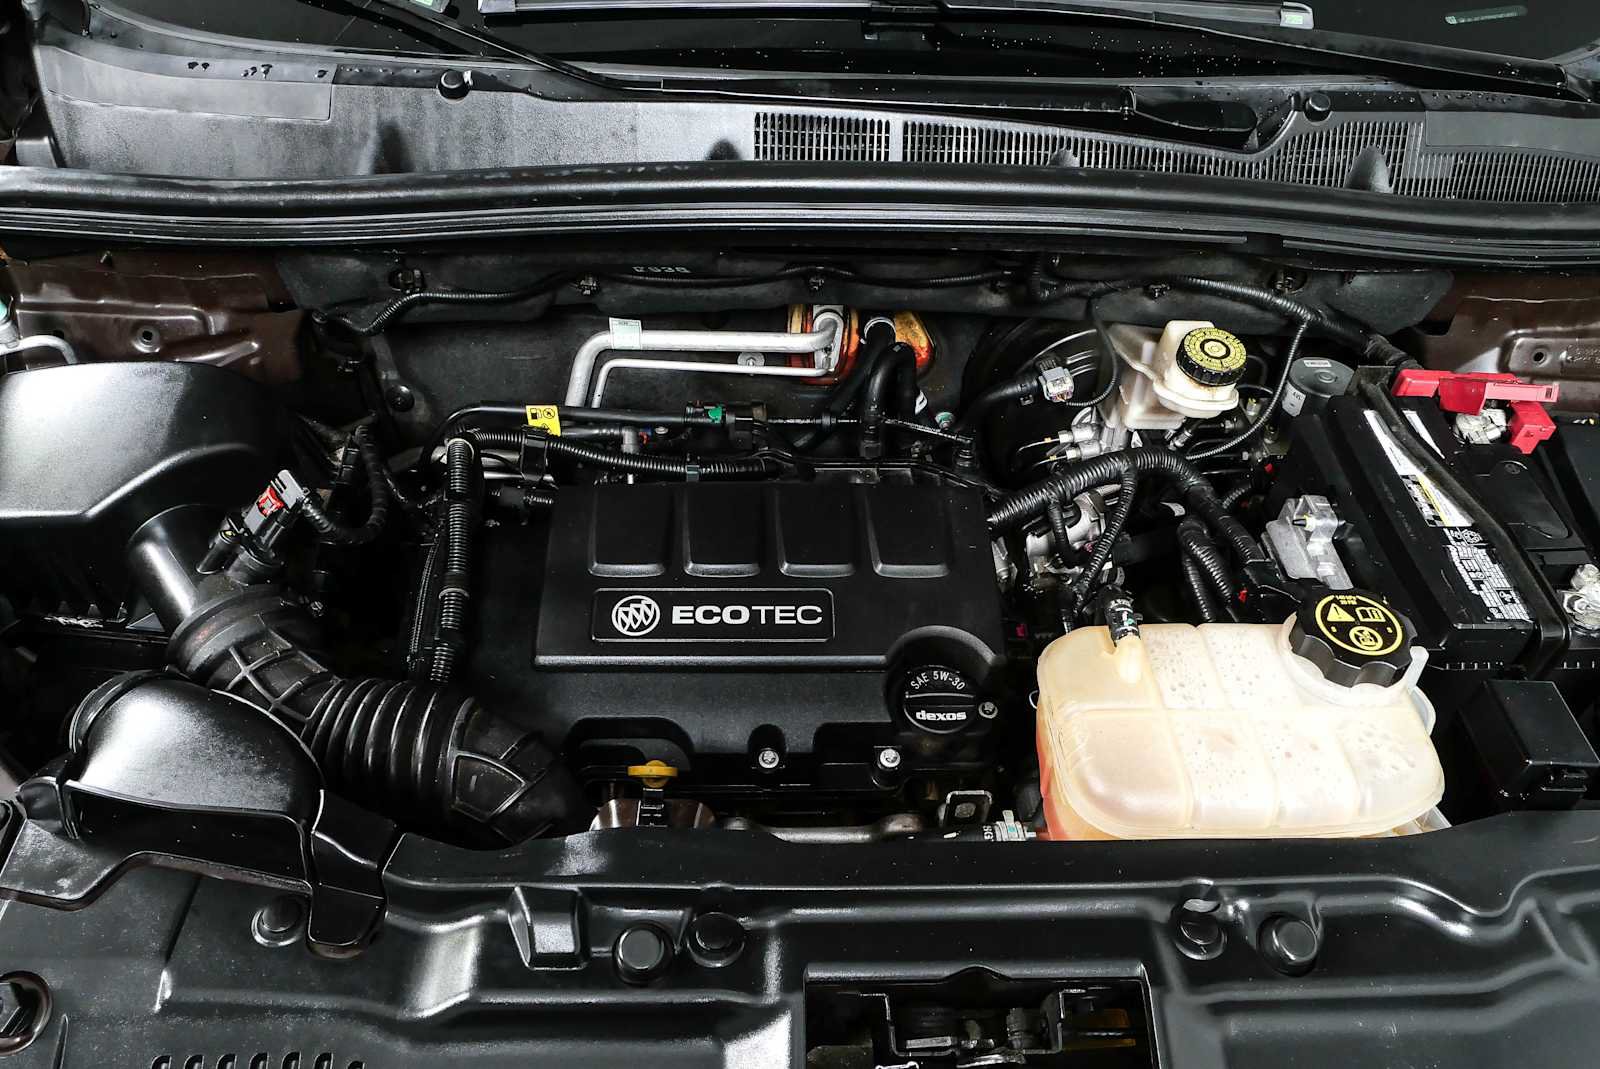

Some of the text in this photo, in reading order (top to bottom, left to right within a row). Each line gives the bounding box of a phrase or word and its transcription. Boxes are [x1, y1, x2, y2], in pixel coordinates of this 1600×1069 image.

[671, 605, 823, 625] ECOTEC
[910, 670, 966, 690] SAE 5W-30
[915, 709, 967, 721] dexos
